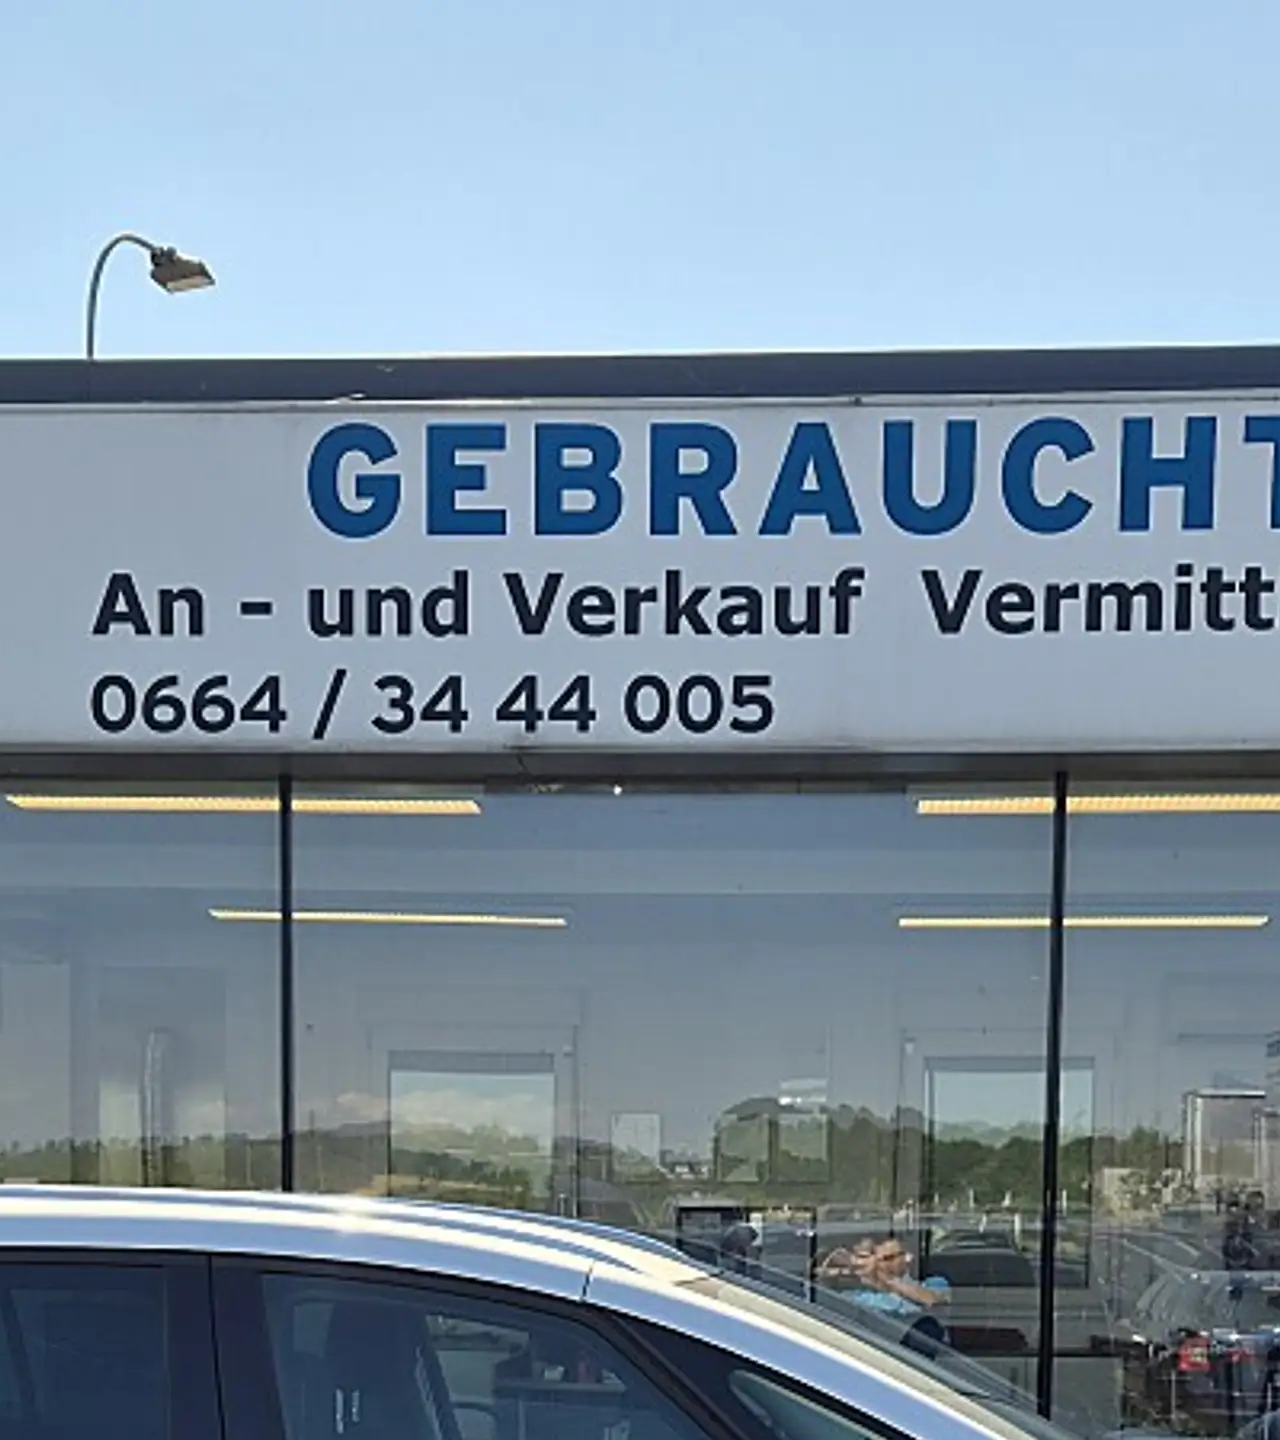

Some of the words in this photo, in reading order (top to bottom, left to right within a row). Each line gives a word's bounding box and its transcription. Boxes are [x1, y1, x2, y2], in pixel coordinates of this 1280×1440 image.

[92, 572, 204, 636] An
[308, 569, 469, 637] und
[502, 567, 866, 637] Verkauf
[91, 675, 287, 734] 0664
[312, 668, 347, 740] /
[371, 675, 469, 734] 34
[495, 675, 597, 734] 44
[624, 674, 774, 734] 005
